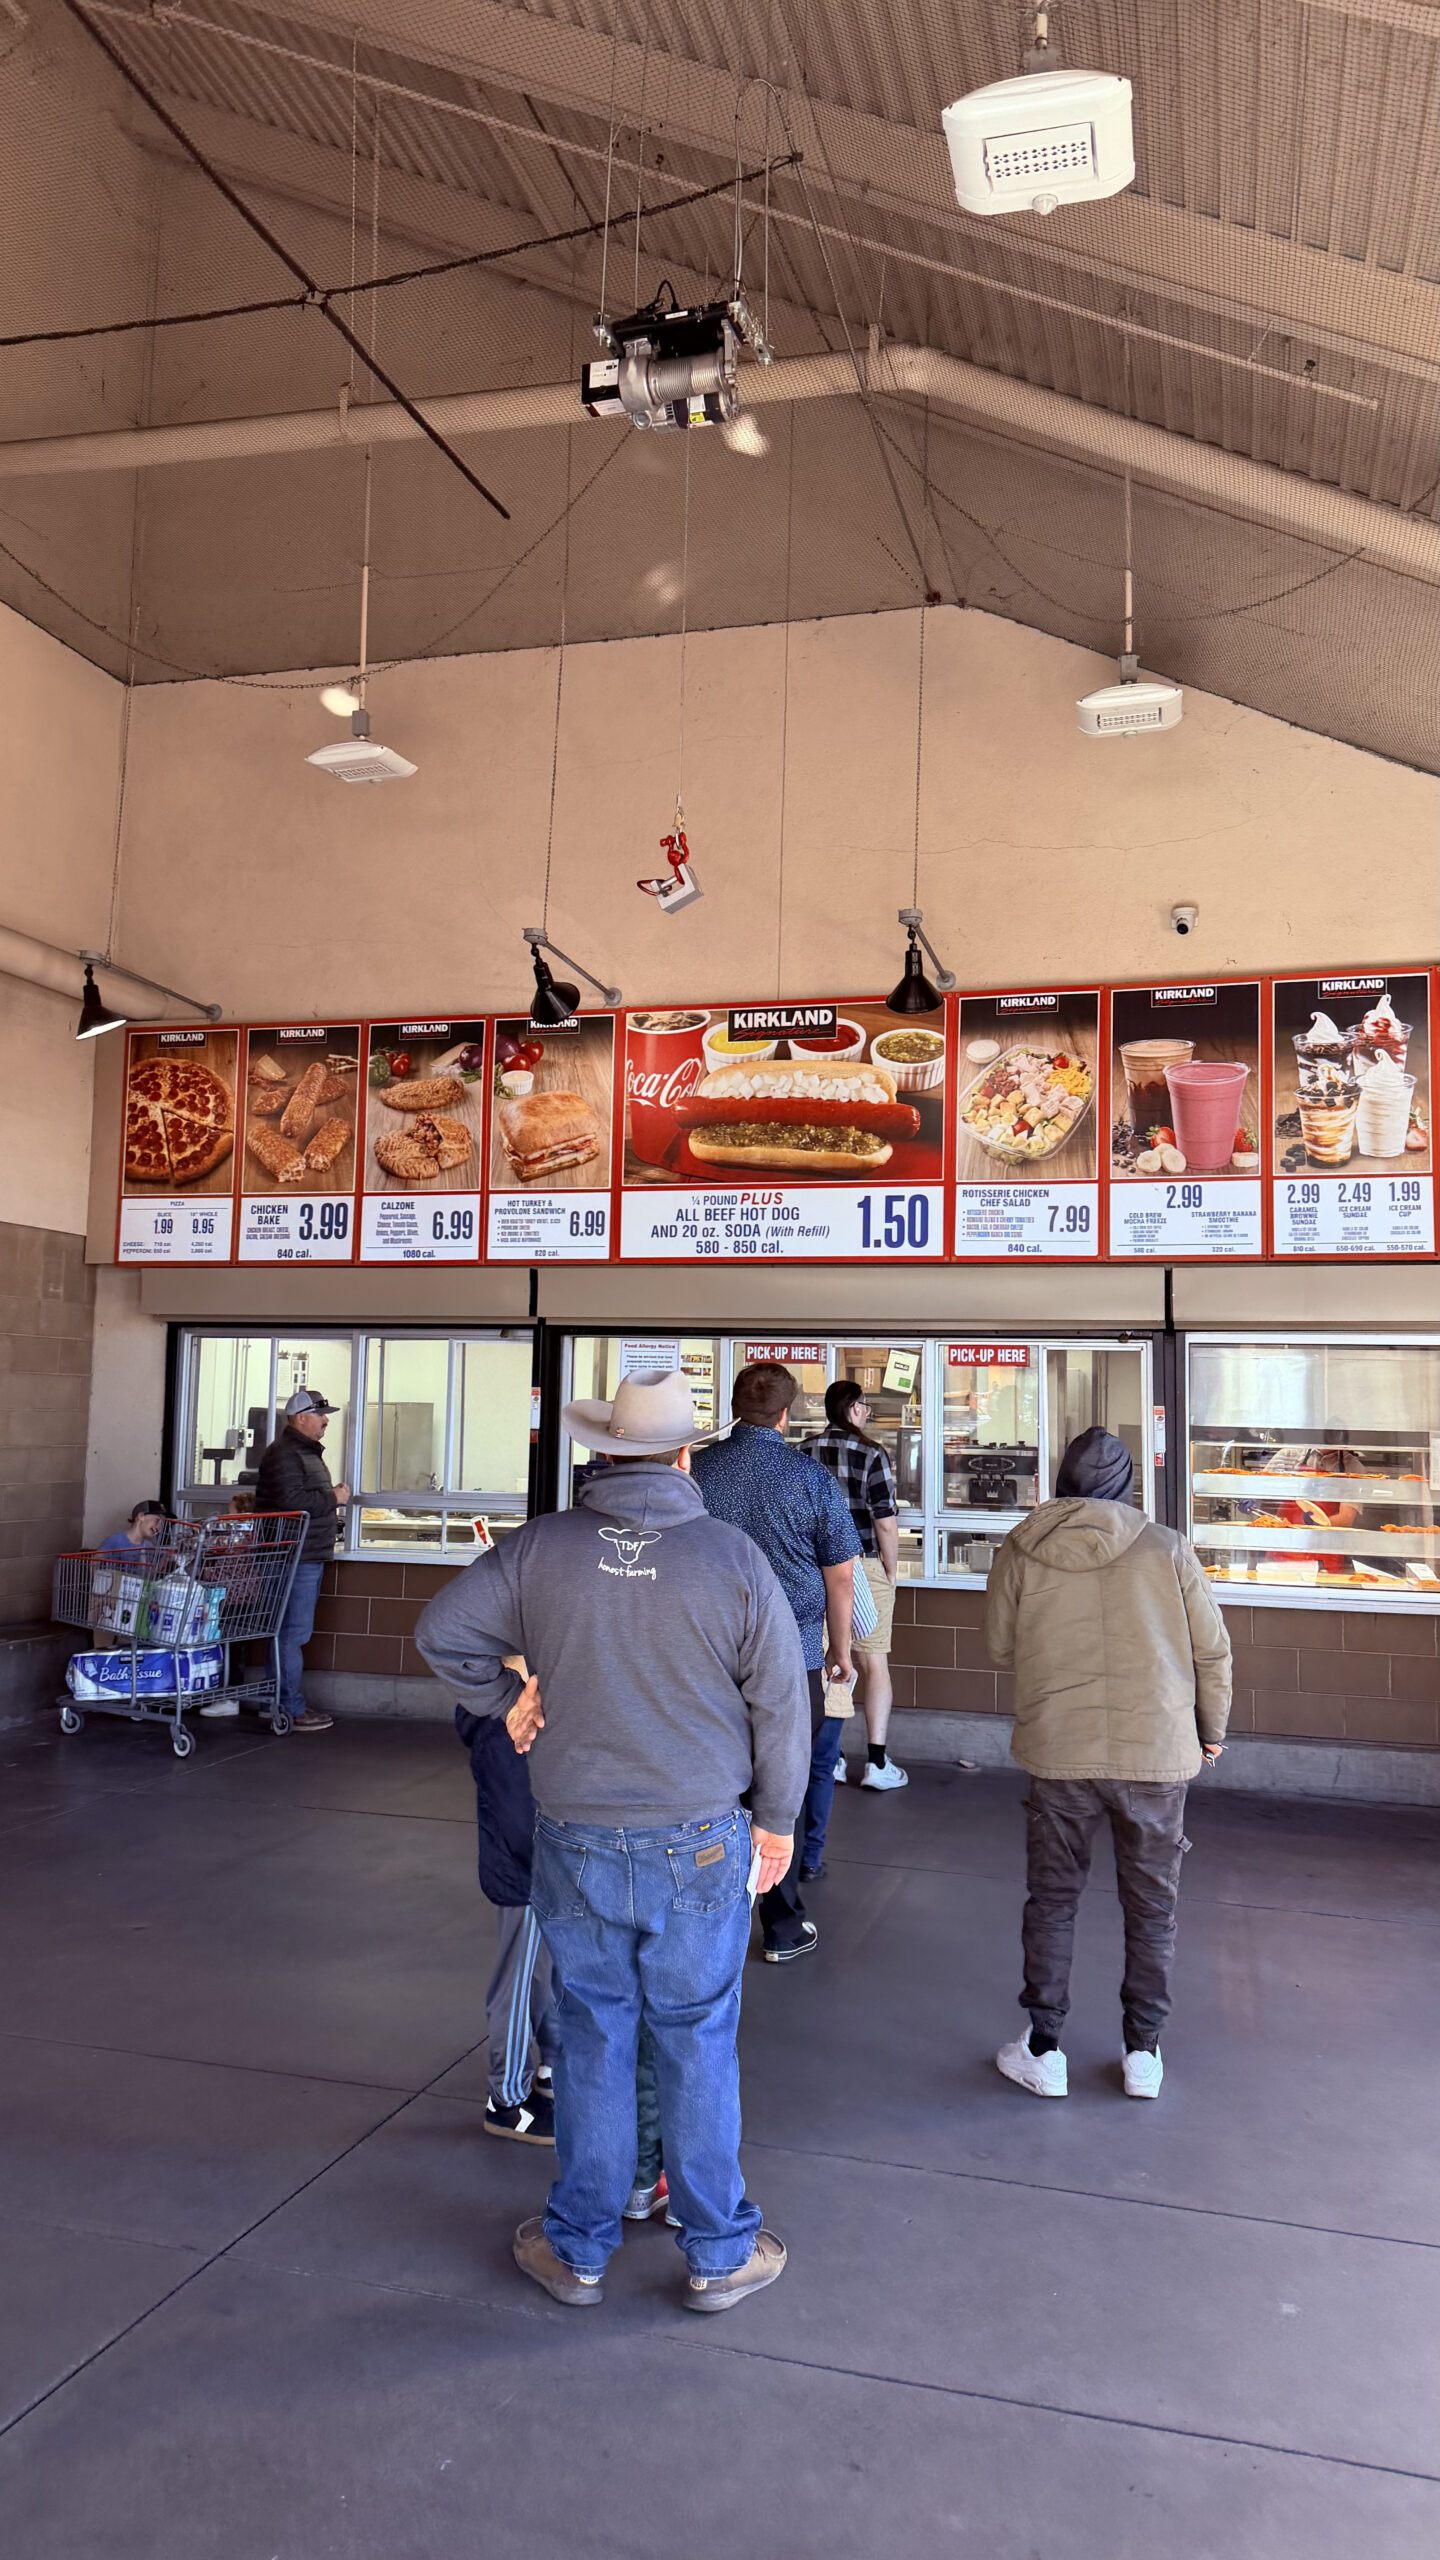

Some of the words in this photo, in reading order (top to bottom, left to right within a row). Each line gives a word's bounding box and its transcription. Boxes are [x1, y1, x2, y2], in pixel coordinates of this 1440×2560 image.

[1322, 979, 1384, 991] KIRKLAND
[1155, 988, 1214, 1000] KIRKLAND
[1000, 996, 1056, 1007] KIRKLAND
[734, 1009, 833, 1029] KIRKLAND
[280, 1029, 324, 1038] KIRKLAND
[402, 1024, 448, 1033] KIRKLAND
[733, 1027, 832, 1041] Signature
[161, 1033, 204, 1042] KIRKLAND
[703, 1195, 737, 1205] POUND
[740, 1192, 784, 1205] PLUS
[962, 1189, 1012, 1198] ROTISSERIE
[1013, 1189, 1049, 1198] CHICKEN
[1166, 1184, 1202, 1209] 2.99
[1288, 1184, 1320, 1204] 2.99
[1338, 1182, 1371, 1202] 2.49
[1389, 1181, 1420, 1202] 1.99
[251, 1205, 288, 1214] CHICKEN
[381, 1202, 415, 1210] CALZONE
[980, 1199, 1000, 1207] CHEF
[1003, 1199, 1031, 1207] SALAD
[257, 1216, 280, 1225] BAKE
[299, 1202, 348, 1240] 3.99
[676, 1208, 700, 1221] ALL
[704, 1208, 736, 1221] BEEF
[740, 1207, 767, 1221] HOT
[771, 1207, 800, 1220] DOG
[857, 1194, 929, 1248] 1.50
[1047, 1205, 1090, 1233] 7.99
[154, 1218, 173, 1234] 1.99
[192, 1218, 215, 1234] 9.95
[432, 1210, 473, 1240] 6.99
[569, 1210, 605, 1236] 6.99
[651, 1225, 677, 1238] AND
[682, 1225, 698, 1238] 20
[702, 1227, 720, 1238] oz.
[725, 1224, 761, 1237] SODA
[766, 1225, 794, 1239] (With
[797, 1225, 830, 1238] Refill)
[277, 1249, 293, 1258] 840
[295, 1248, 312, 1258] cal.
[403, 1250, 421, 1258] 1080
[422, 1250, 436, 1258] cal.
[534, 1249, 546, 1257] 820
[548, 1249, 560, 1257] cal.
[696, 1240, 719, 1254] 580
[733, 1240, 757, 1253] 850
[761, 1240, 784, 1253] cal.
[1008, 1244, 1024, 1252] 840
[1026, 1244, 1042, 1252] cal.
[747, 1346, 788, 1360] PICK-UP
[791, 1346, 817, 1360] HERE
[950, 1349, 994, 1362] PICK-UP
[998, 1349, 1026, 1362] HERE
[619, 1541, 640, 1551] TDF
[598, 1557, 624, 1576] honest
[625, 1565, 656, 1580] farming
[100, 1666, 128, 1681] Bath
